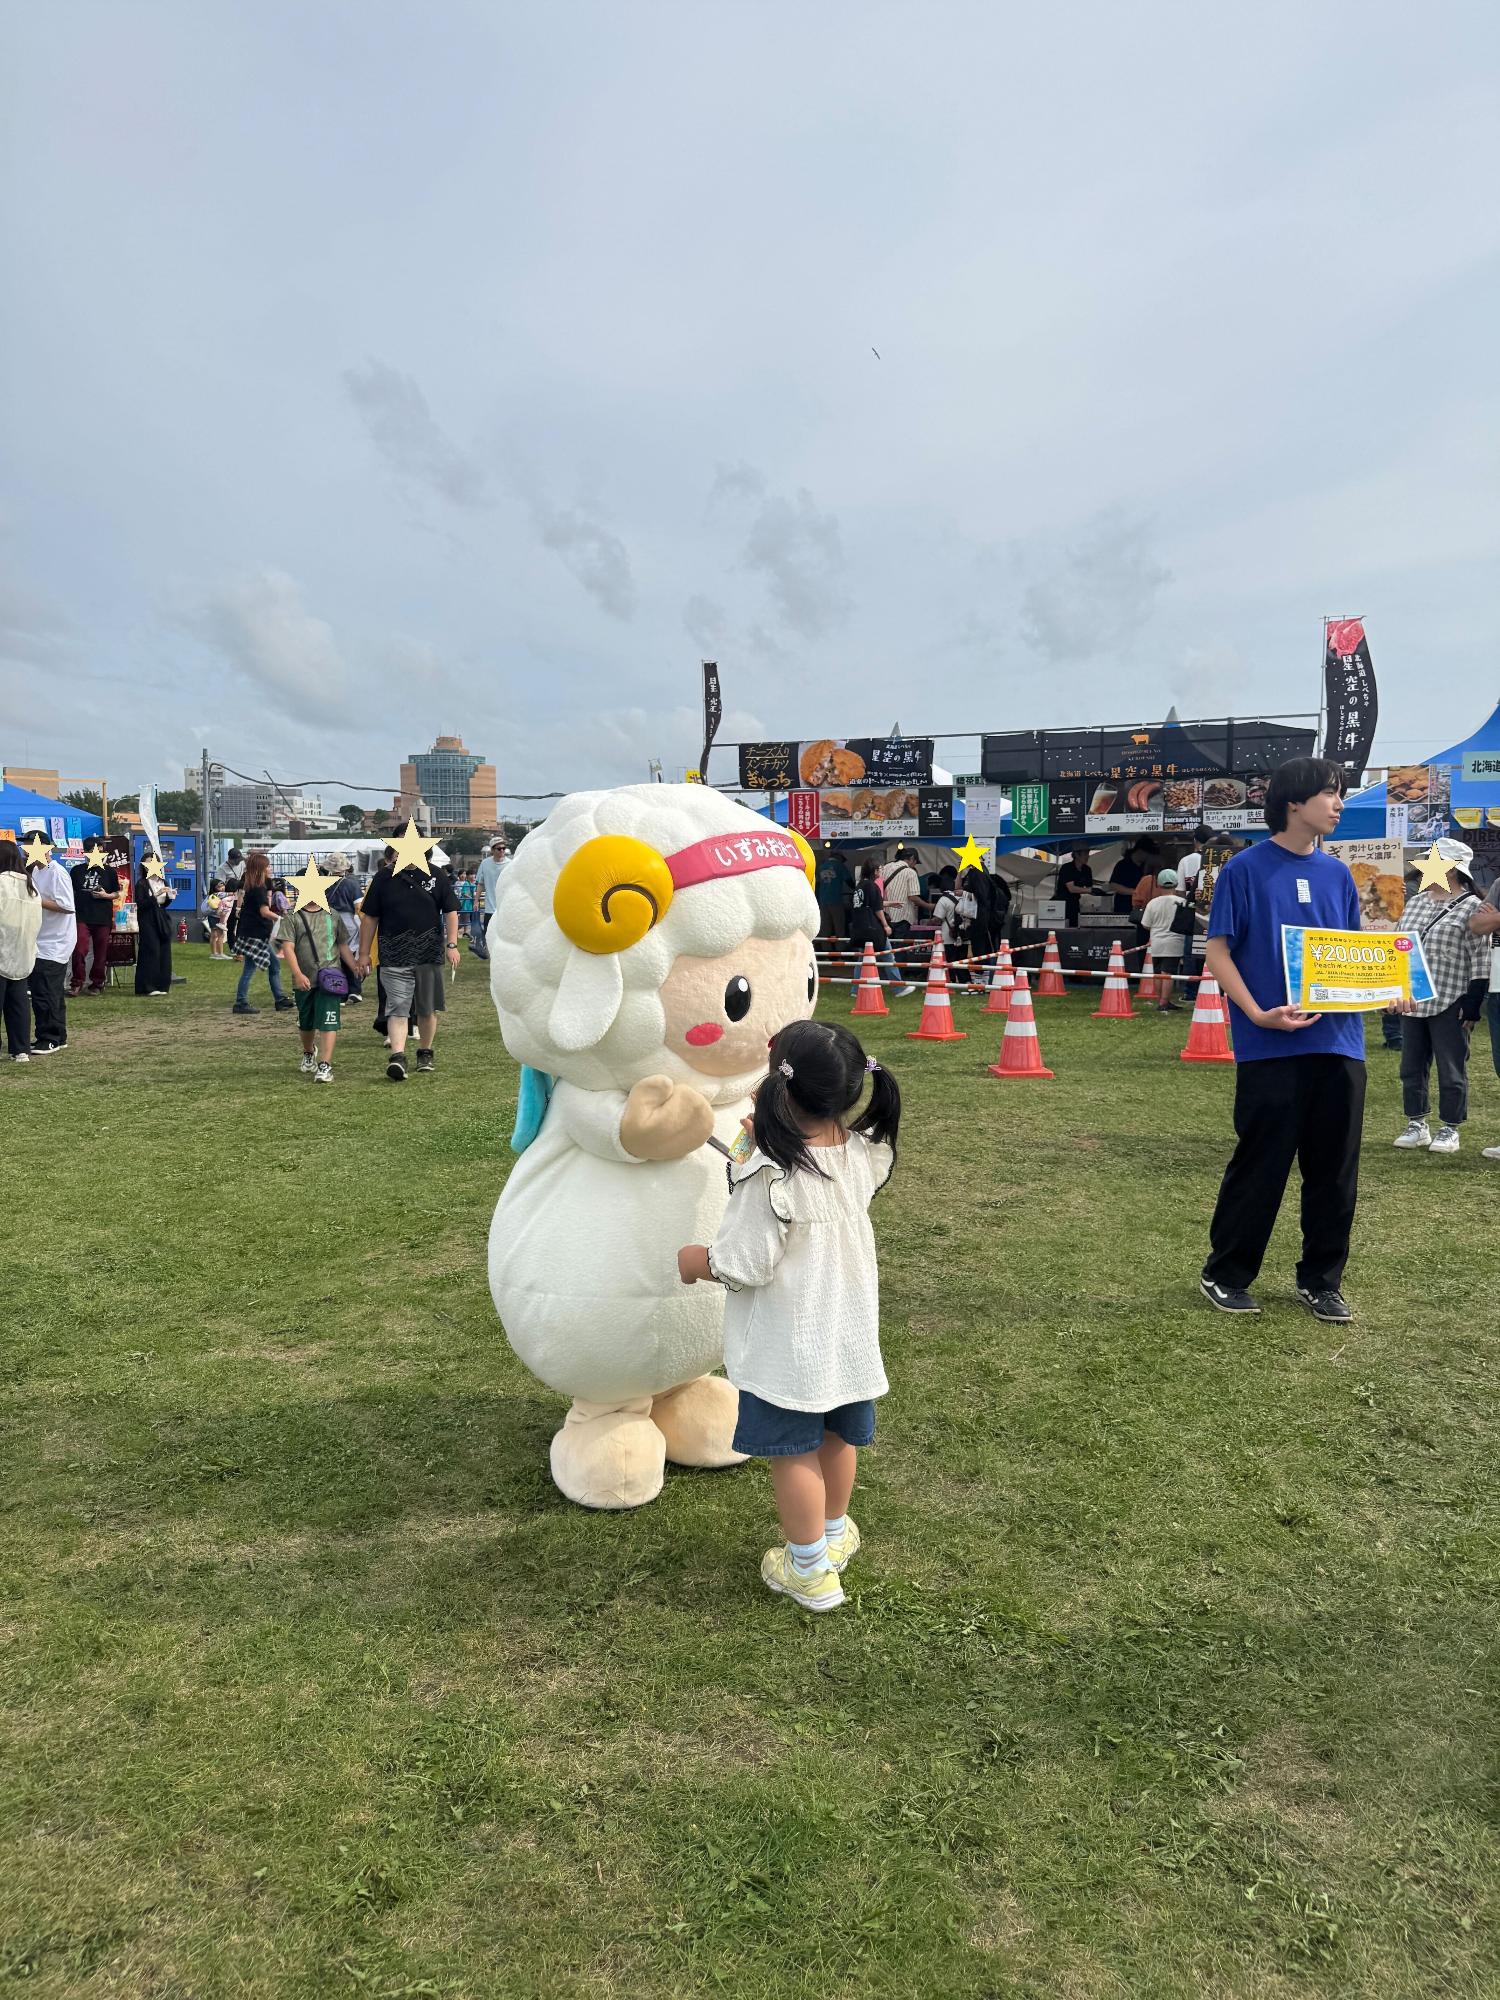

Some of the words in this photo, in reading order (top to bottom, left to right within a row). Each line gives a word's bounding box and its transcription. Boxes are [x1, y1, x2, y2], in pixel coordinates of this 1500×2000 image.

[1342, 655, 1360, 751] 星空の黒牛
[745, 746, 790, 757] チーズ入り
[871, 750, 921, 764] 星空の黒牛
[745, 758, 790, 770] メンチカツ
[1059, 769, 1081, 778] 北海道
[1110, 763, 1179, 780] 星空の黒牛
[746, 770, 792, 788] ぎゅっち
[1348, 843, 1401, 852] 肉汁じゅわっ!
[1309, 943, 1386, 963] ¥20,000
